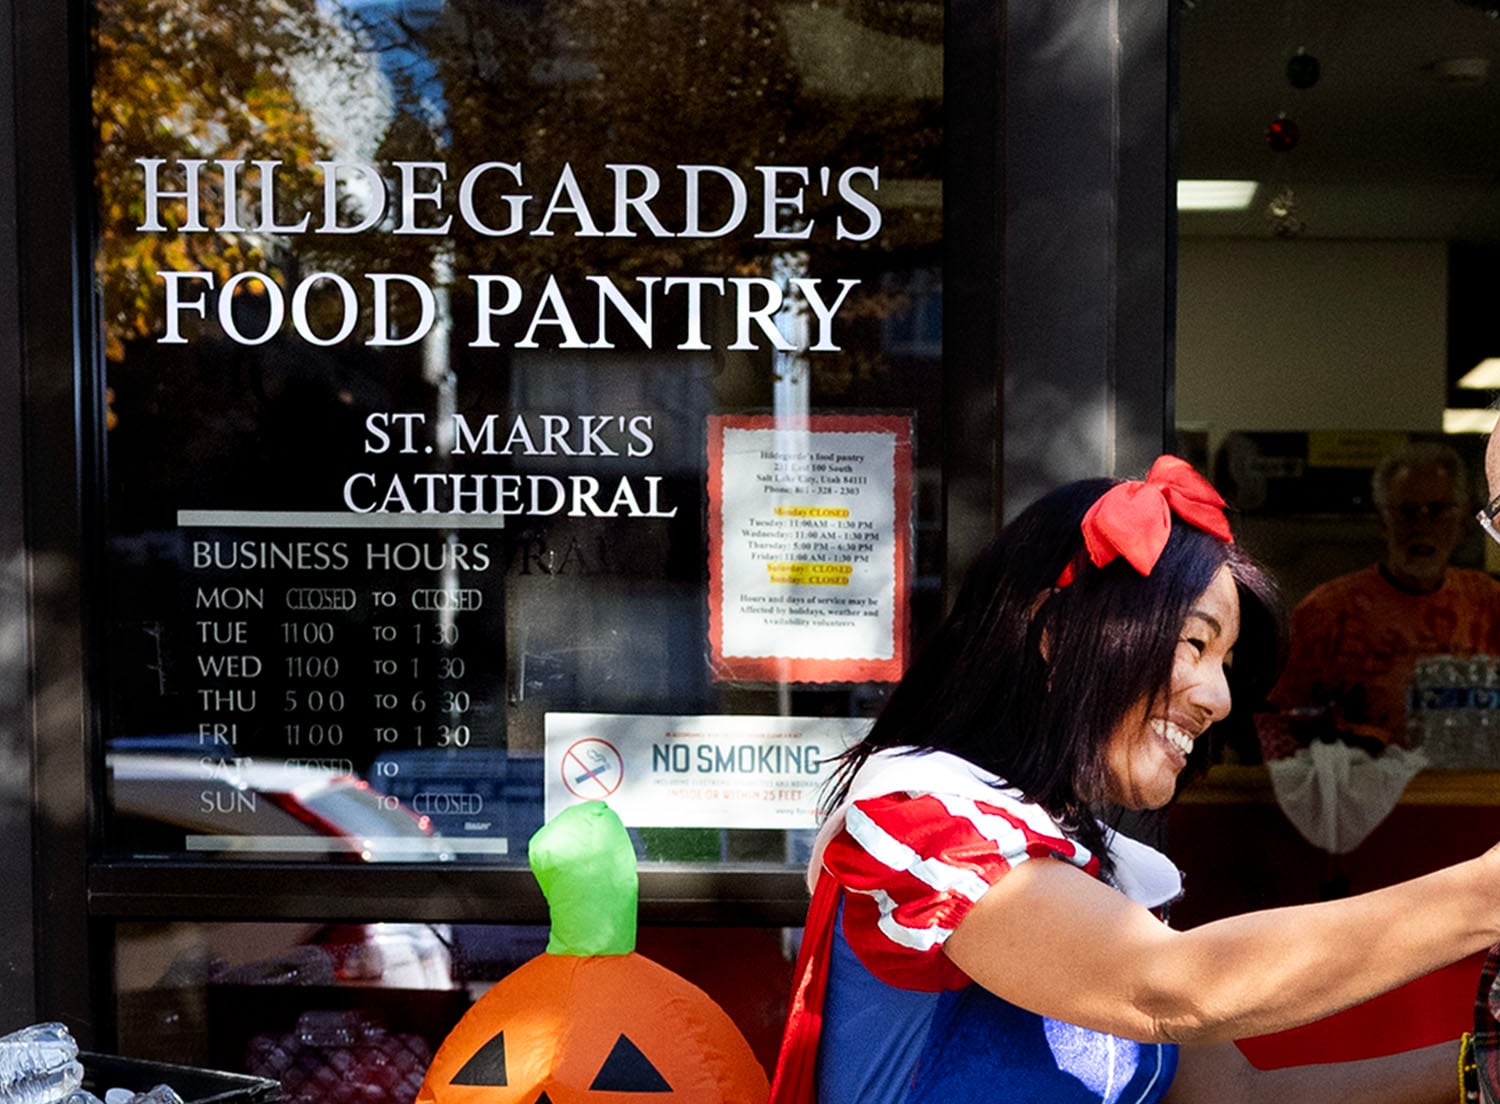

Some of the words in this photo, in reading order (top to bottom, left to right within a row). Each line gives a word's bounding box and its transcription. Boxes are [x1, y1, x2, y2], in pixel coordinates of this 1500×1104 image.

[134, 157, 882, 242] HILDEGARDE'S
[156, 270, 437, 347] FOOD
[468, 273, 862, 353] PANTRY
[363, 412, 434, 455] ST.
[451, 414, 654, 458] MARK'S
[342, 474, 678, 518] CATHEDRAL
[809, 508, 850, 518] CLOSED
[192, 541, 348, 570] BUSINESS
[366, 543, 491, 572] HOURS
[812, 565, 853, 574] CLOSED
[808, 576, 850, 586] CLOSED
[196, 588, 264, 609] MON
[286, 588, 356, 610] CLOSED
[372, 592, 397, 607] TO
[411, 588, 482, 612] CLOSED
[196, 622, 248, 644] TUE
[372, 626, 397, 641] TO
[198, 656, 262, 678] WED
[373, 660, 398, 676] TO
[198, 690, 256, 712] THU
[374, 694, 398, 710] TO
[198, 723, 237, 746] FRI
[374, 728, 398, 743] TO
[200, 757, 250, 779] SAT
[376, 762, 398, 776] TO
[652, 744, 690, 773] NO
[697, 744, 820, 774] SMOKING
[200, 792, 257, 814] SUN
[376, 796, 398, 811] TO
[412, 793, 482, 814] CLOSED
[763, 790, 776, 800] 25
[778, 790, 802, 800] FEET
